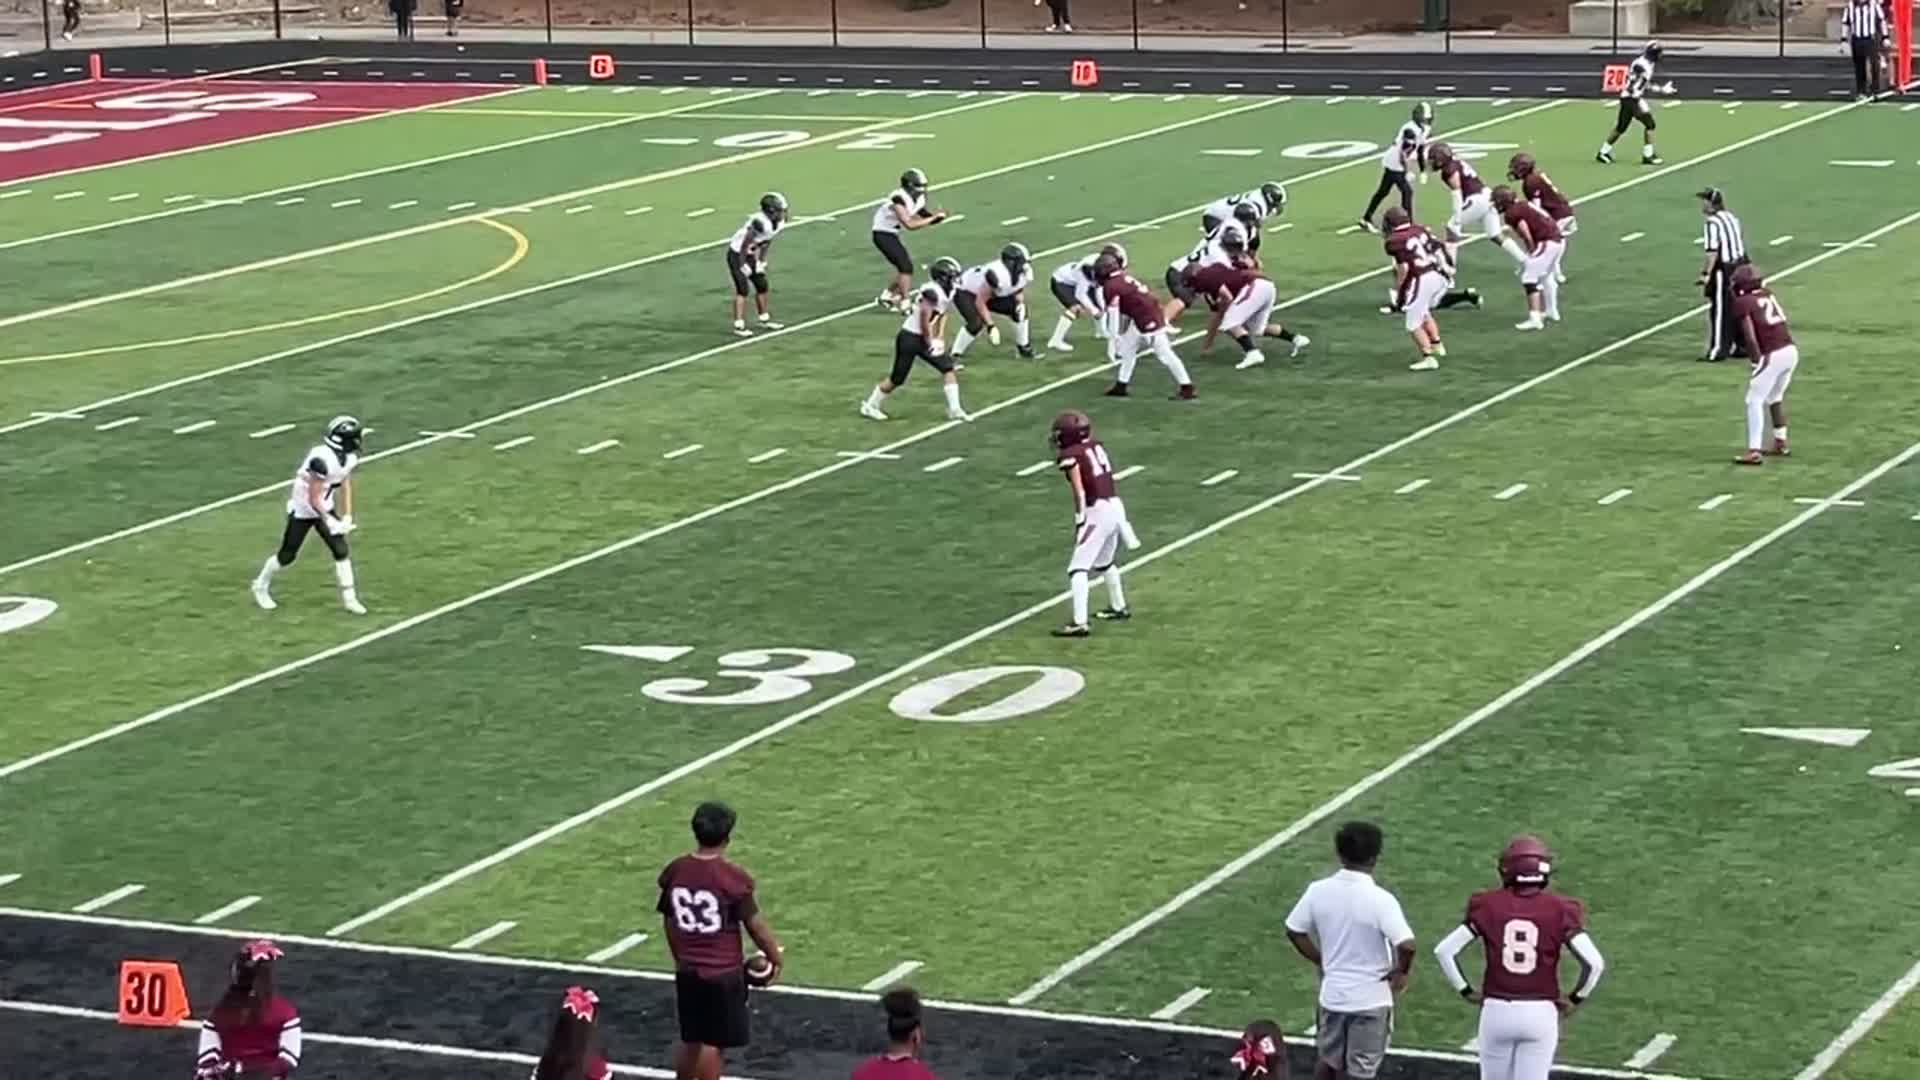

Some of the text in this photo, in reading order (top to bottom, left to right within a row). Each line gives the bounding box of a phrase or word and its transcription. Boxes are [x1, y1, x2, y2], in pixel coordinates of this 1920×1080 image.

[593, 59, 608, 74] G
[1075, 65, 1091, 81] 10
[1607, 69, 1625, 86] 20
[1085, 444, 1112, 477] 14
[641, 647, 1086, 723] 30
[671, 886, 722, 934] 63
[1502, 918, 1539, 975] 8
[125, 971, 167, 1018] 30
